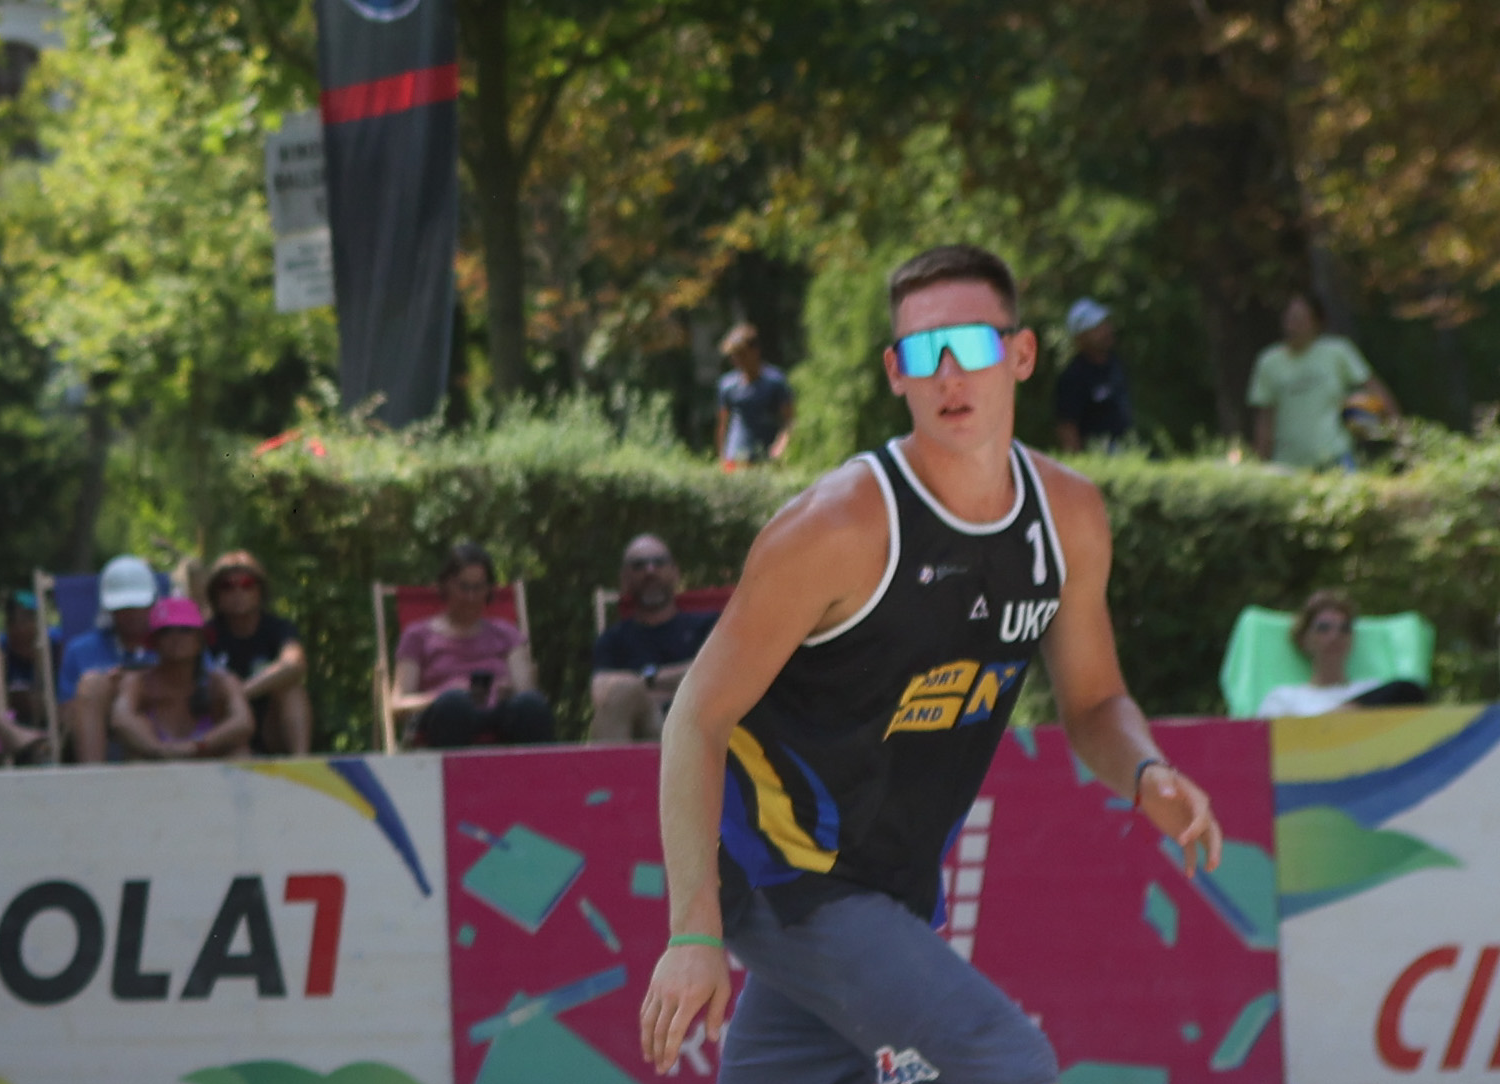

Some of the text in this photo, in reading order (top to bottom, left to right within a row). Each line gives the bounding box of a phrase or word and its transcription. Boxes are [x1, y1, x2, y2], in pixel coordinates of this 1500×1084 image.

[1024, 519, 1048, 587] 1
[896, 706, 943, 723] AND
[1374, 941, 1500, 1074] CI
